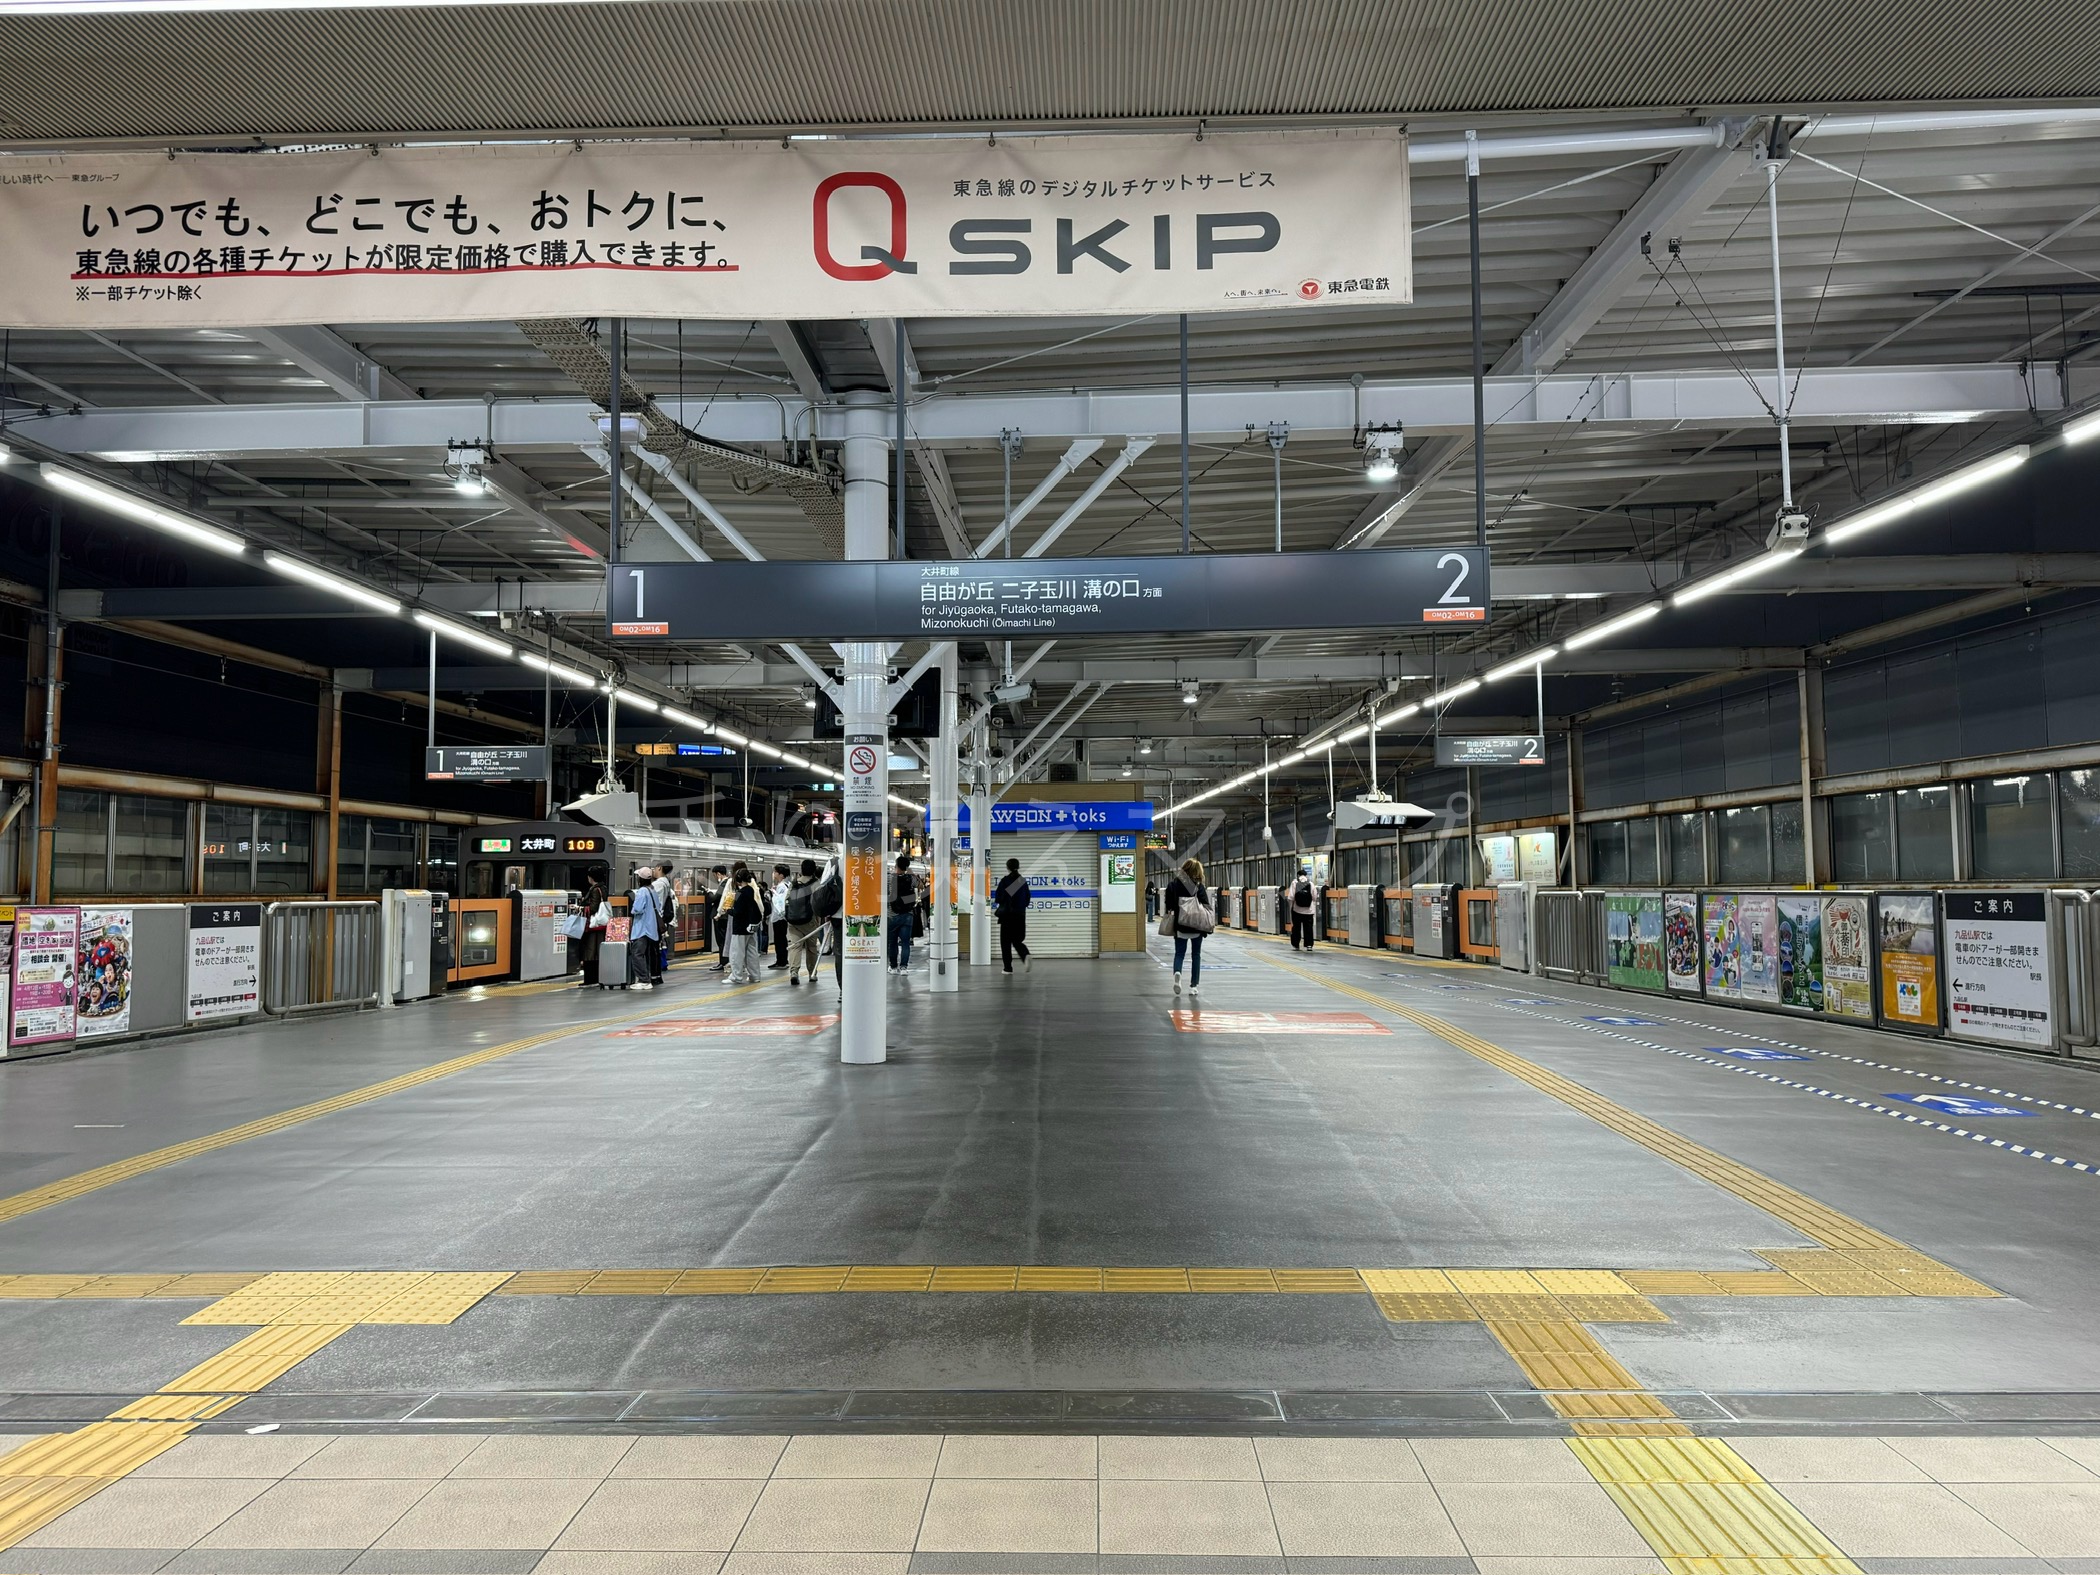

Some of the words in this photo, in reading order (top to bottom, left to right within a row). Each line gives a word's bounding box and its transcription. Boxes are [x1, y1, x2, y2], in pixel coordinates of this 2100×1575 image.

[0, 173, 54, 185] しい時代へ
[953, 171, 1276, 199] 東急線のデジタルチケットサービス
[80, 195, 271, 238] いつでも、
[304, 192, 503, 236] どこでも、
[529, 188, 729, 231] おトクに、
[75, 241, 731, 276] 東急線の各種チケットが限定価格で購入できます。
[75, 284, 202, 302] ※一部チケット除く
[1327, 277, 1390, 295] 東急電鉄
[921, 566, 960, 577] 大井町線
[1436, 553, 1470, 604] 2
[629, 569, 644, 618] 1
[921, 581, 995, 601] 自由が丘
[1001, 580, 1076, 599] 二子玉川
[1083, 579, 1140, 599] 溝の口
[1143, 587, 1162, 598] 方面
[921, 604, 936, 616] for
[1000, 603, 1102, 615] Futako-tamagawa,
[921, 617, 989, 629] Mizonokuchi
[1033, 616, 1056, 628] Line)
[470, 751, 498, 759] 自由が丘
[499, 751, 528, 759] 二子玉川
[1524, 738, 1538, 758] 2
[436, 749, 444, 772] 1
[852, 776, 872, 785] 禁煙
[990, 809, 1052, 823] AWSON
[1071, 808, 1107, 823] toks
[521, 838, 556, 850] 大井町
[567, 839, 595, 850] 109
[864, 845, 875, 880] 今夜は、
[850, 846, 860, 910] 座って帰ろう。
[1062, 875, 1086, 886] toks
[1974, 898, 2013, 914] ご案内
[212, 910, 241, 922] ご案内
[195, 936, 225, 945] 九品仏駅では
[1954, 930, 1993, 941] 九品仏駅では
[194, 945, 255, 957] 電車のドアーが一部開きま
[1954, 942, 2040, 957] 電車のドアーが一部開きま
[194, 955, 251, 967] せんのでご注意ください。
[1955, 955, 2034, 970] せんのでご注意ください。
[1964, 982, 1986, 993] 進行方向
